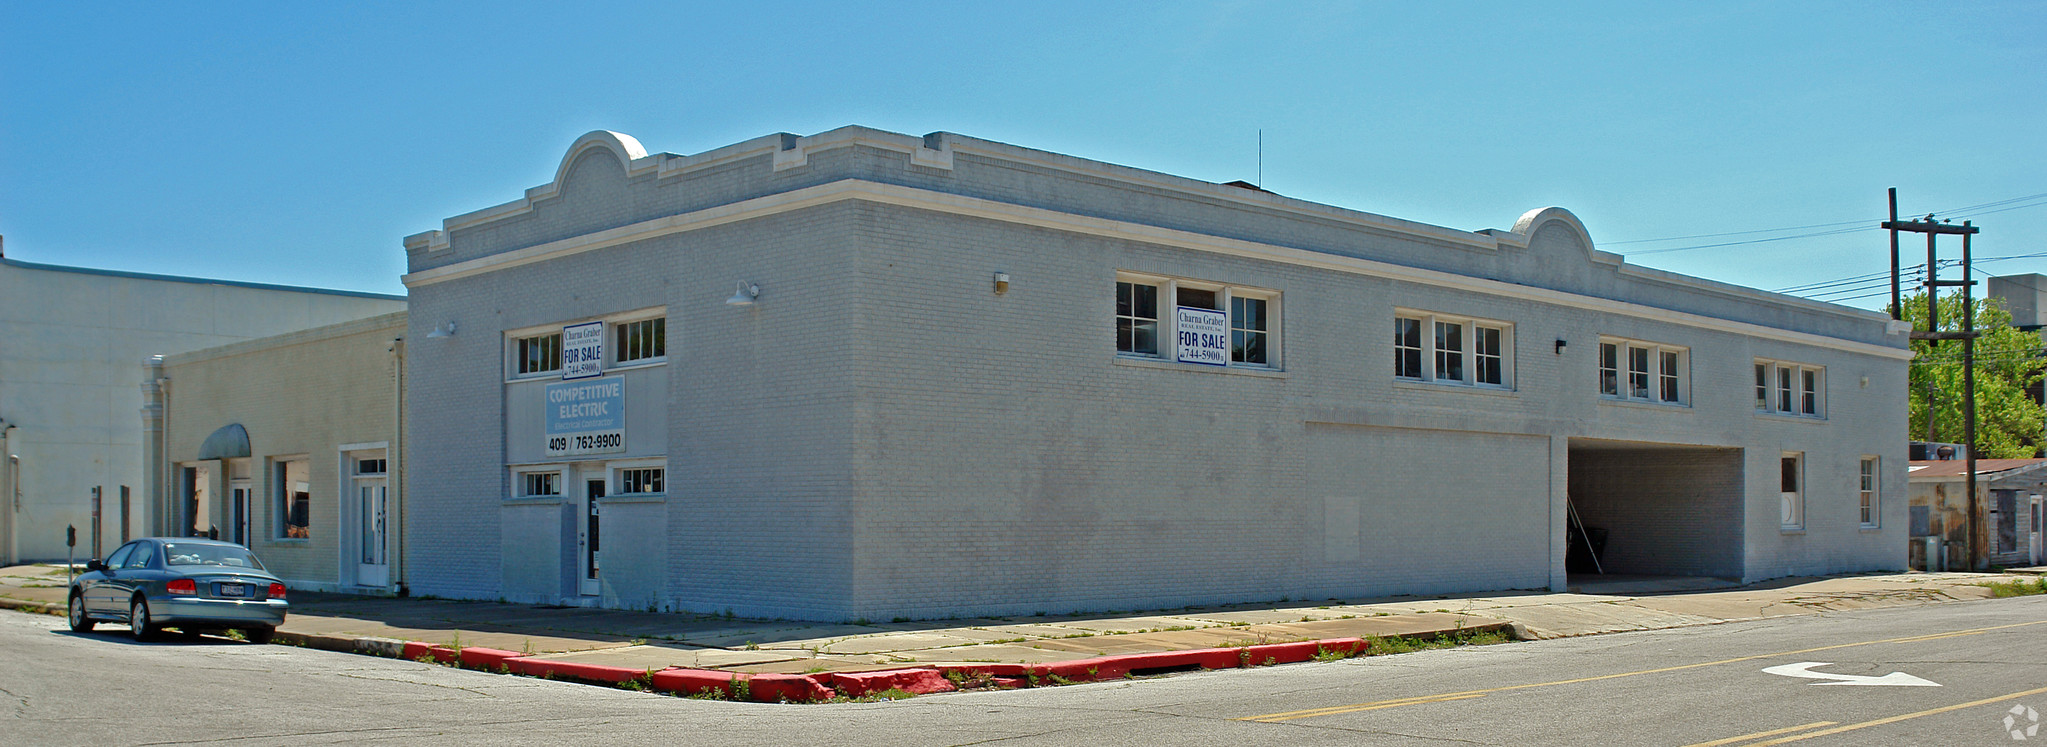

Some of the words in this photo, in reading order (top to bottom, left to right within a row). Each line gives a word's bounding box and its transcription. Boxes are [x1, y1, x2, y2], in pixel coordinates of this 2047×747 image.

[1180, 312, 1202, 324] Charna
[1203, 315, 1224, 327] Graber
[1179, 331, 1198, 347] FOR
[1201, 333, 1225, 350] SALE
[564, 348, 579, 364] FOR
[581, 345, 601, 362] SALE
[1185, 349, 1220, 361] 744-5900
[549, 383, 620, 403] COMPETITIVE
[560, 401, 608, 419] ELECTRIC
[549, 437, 567, 451] 409
[576, 433, 621, 449] 762-9900
